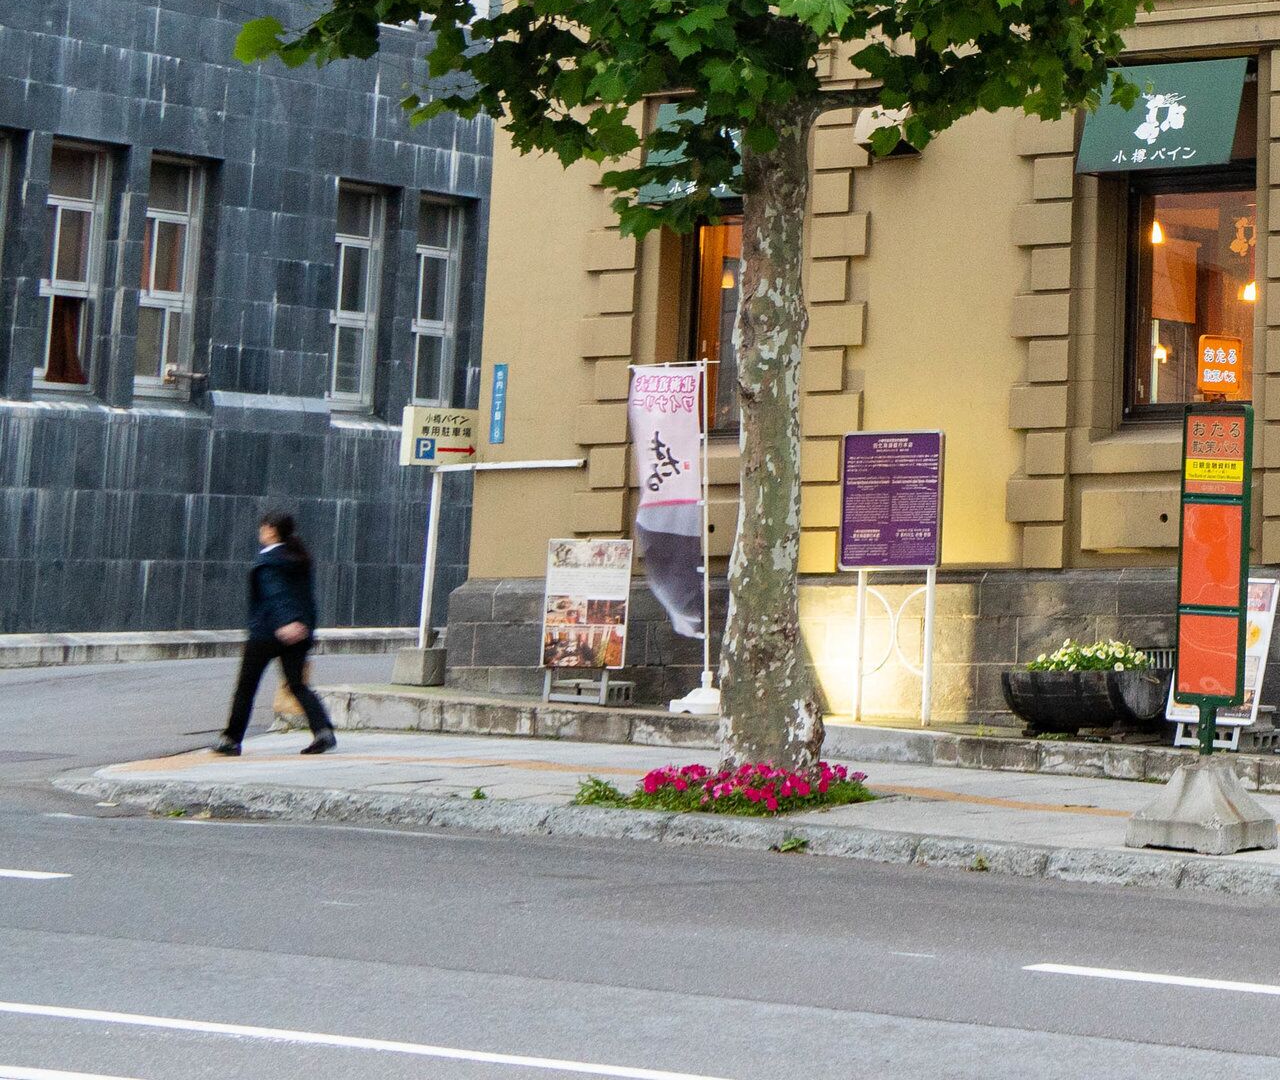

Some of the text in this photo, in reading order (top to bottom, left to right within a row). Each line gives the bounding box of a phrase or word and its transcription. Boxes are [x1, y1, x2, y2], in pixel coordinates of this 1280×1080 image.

[1111, 147, 1197, 163] 小樽バイン
[1203, 347, 1238, 364] おたる
[425, 413, 470, 425] 小樽バイン
[422, 426, 472, 438] 専用駐車場
[1192, 422, 1241, 438] おたる
[420, 440, 432, 458] P
[1192, 440, 1240, 455] 散策バス
